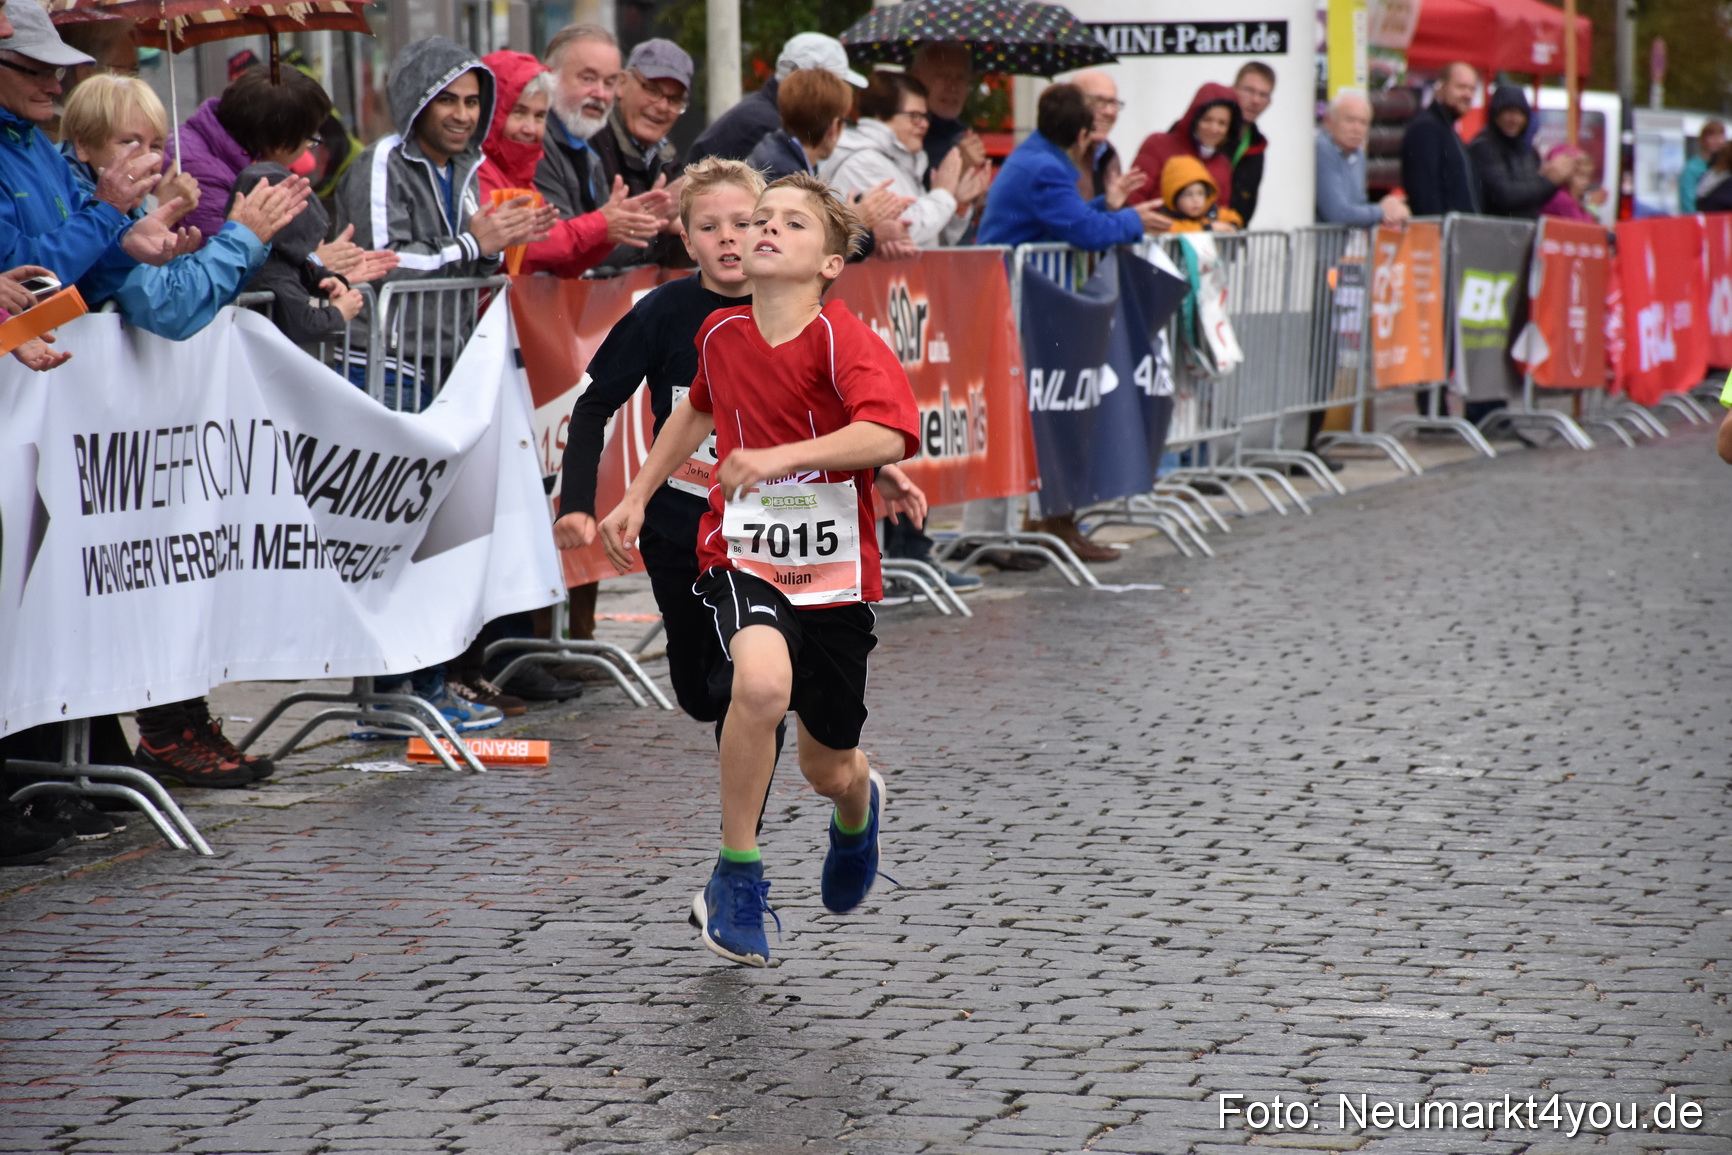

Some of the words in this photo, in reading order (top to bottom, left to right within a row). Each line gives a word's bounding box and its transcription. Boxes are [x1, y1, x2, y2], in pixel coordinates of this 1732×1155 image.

[73, 430, 150, 516] BMW
[773, 494, 818, 506] BOCK
[743, 519, 839, 558] 7015
[733, 545, 742, 554] B6
[773, 571, 812, 585] Julian
